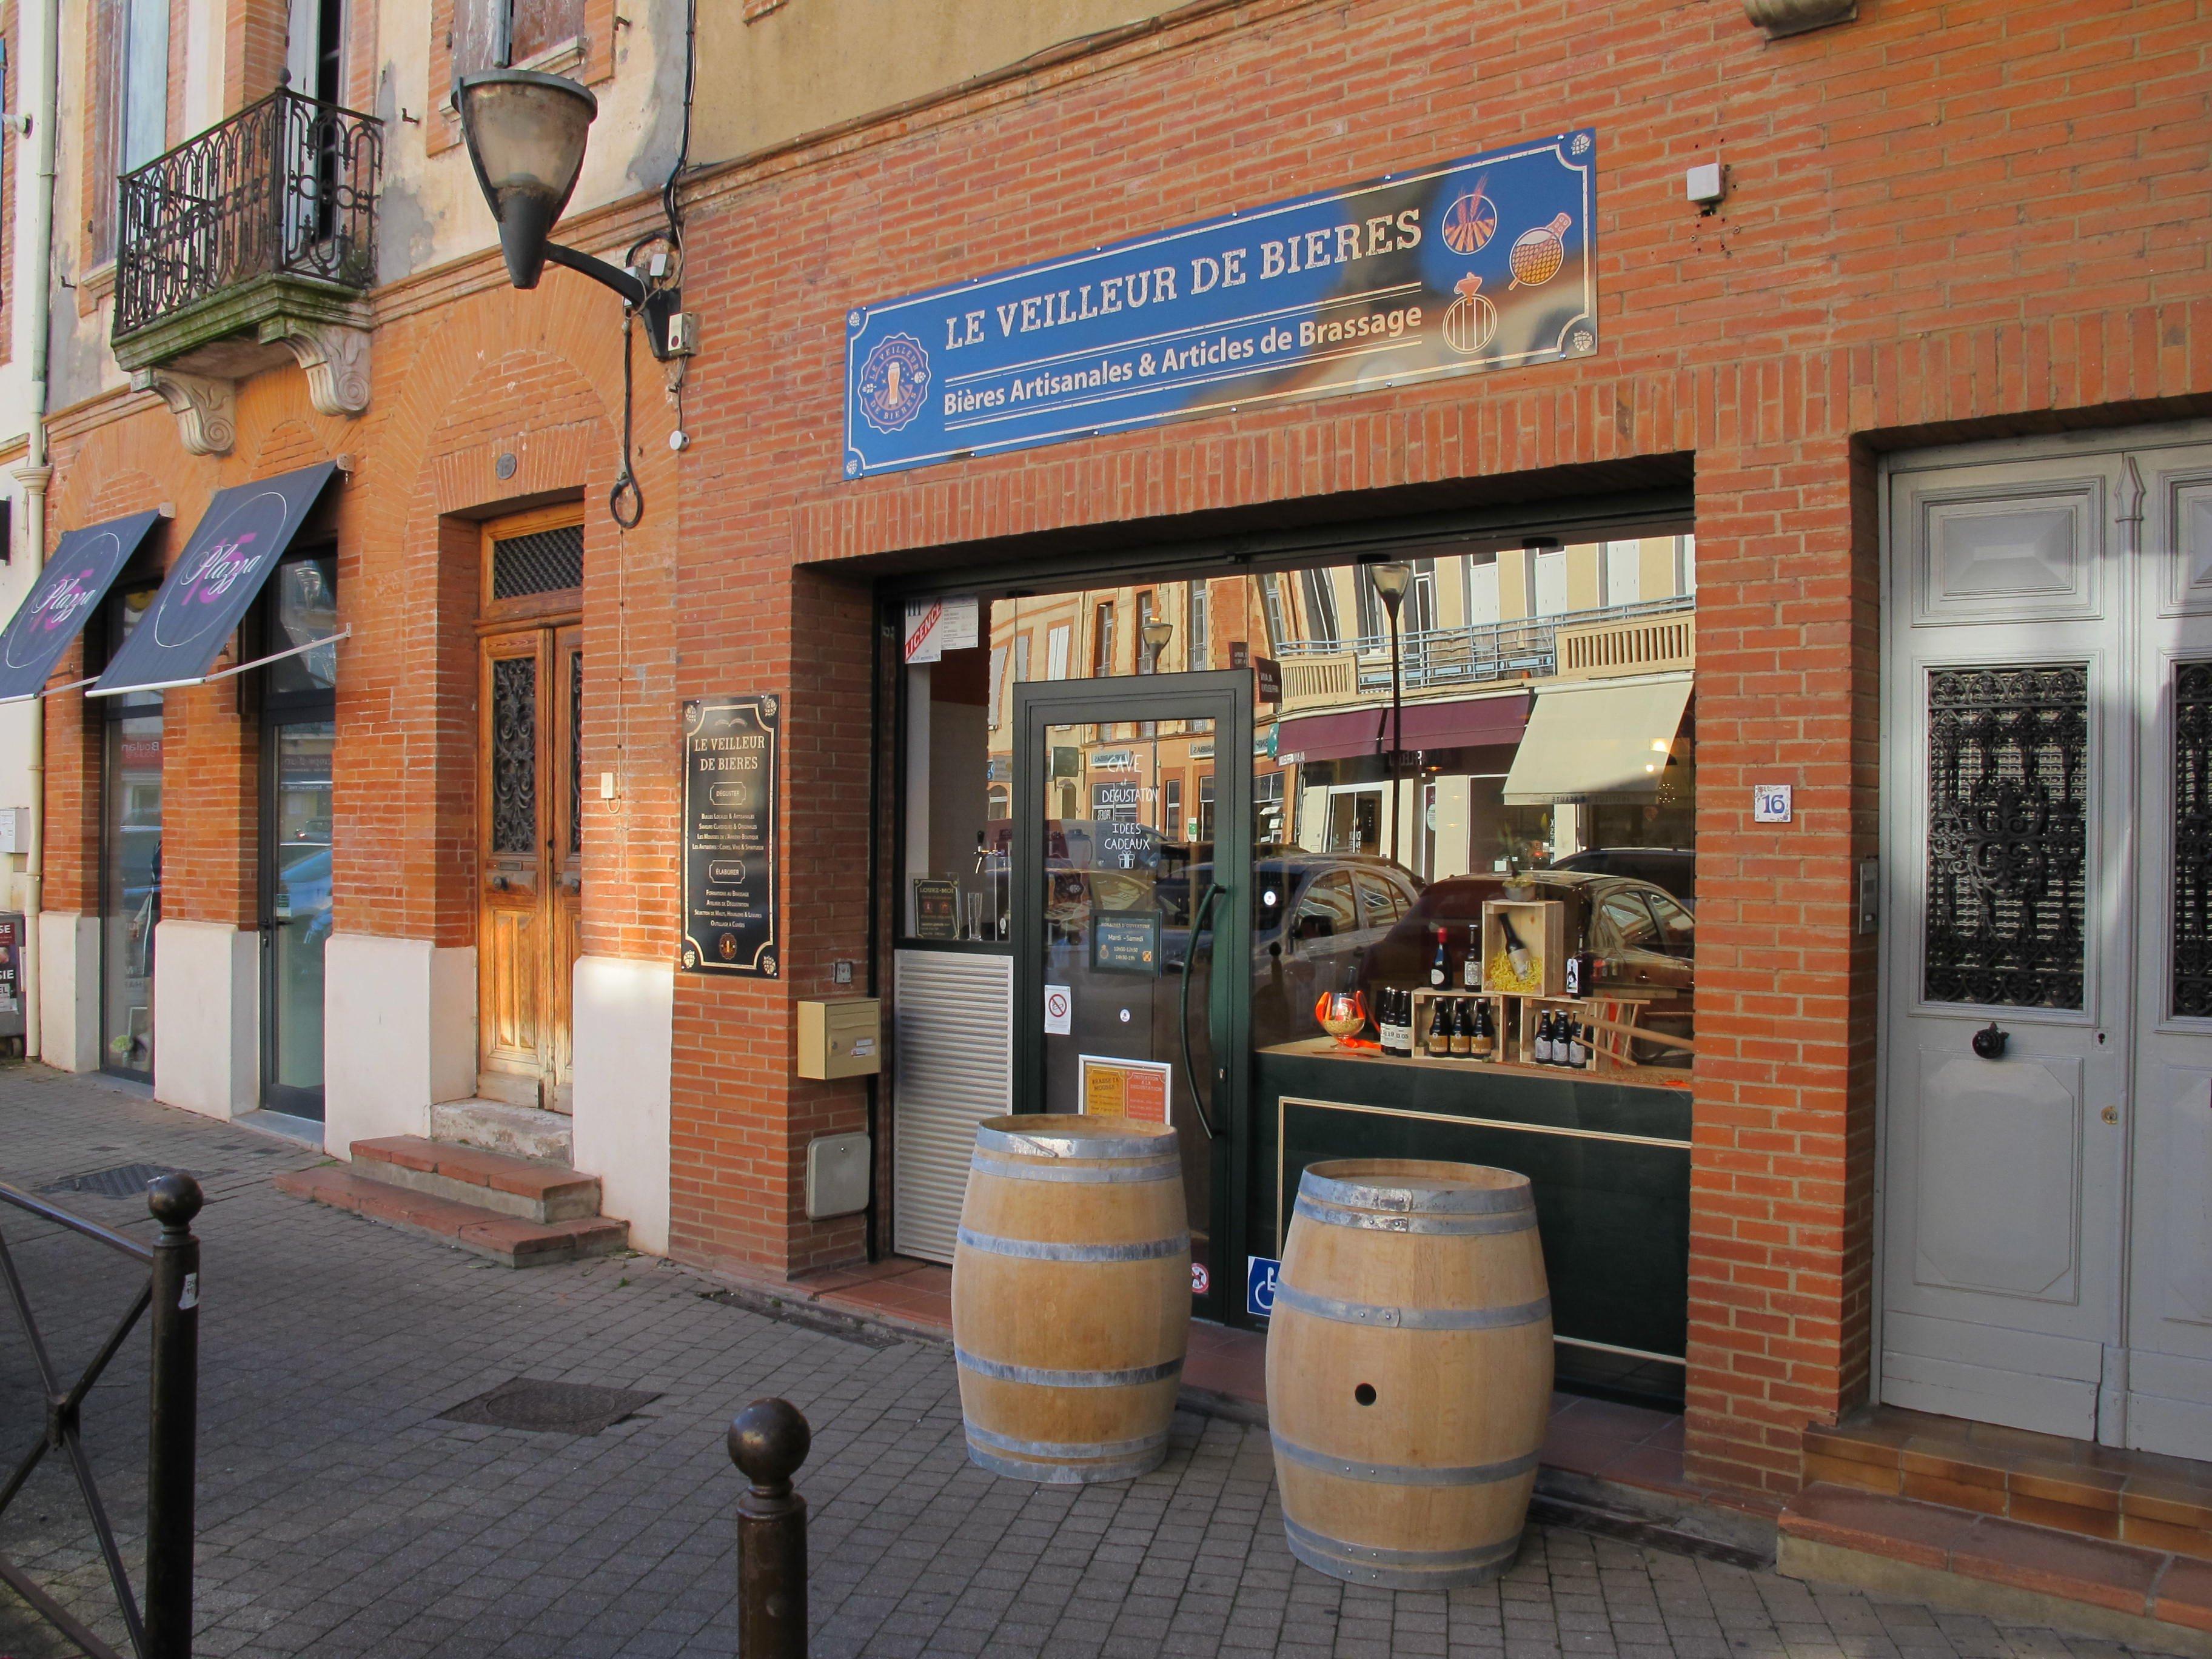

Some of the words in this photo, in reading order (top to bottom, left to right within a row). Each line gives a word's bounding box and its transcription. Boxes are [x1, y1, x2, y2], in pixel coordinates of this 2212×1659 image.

[945, 310, 985, 350] LE
[996, 265, 1178, 337] VEILLEUR
[1191, 247, 1247, 295] DE
[1259, 209, 1422, 280] BIERES
[944, 386, 1005, 416] Bières
[1010, 360, 1133, 403] Artisanales
[1138, 352, 1156, 377] &
[1161, 336, 1254, 374] Articles
[1260, 326, 1292, 354] de
[1299, 306, 1423, 347] Brassage
[180, 543, 263, 595] Plazza
[906, 598, 942, 659] LICENCE
[694, 739, 708, 752] LE
[711, 735, 765, 751] VEILLEUR
[700, 758, 716, 771] DE
[717, 756, 759, 771] BIERES
[1107, 754, 1144, 773] CAVE
[1102, 787, 1160, 803] DEGUSTATION
[1761, 794, 1785, 814] 16
[1111, 822, 1142, 835] IDEES
[1104, 837, 1150, 851] CADEAUX
